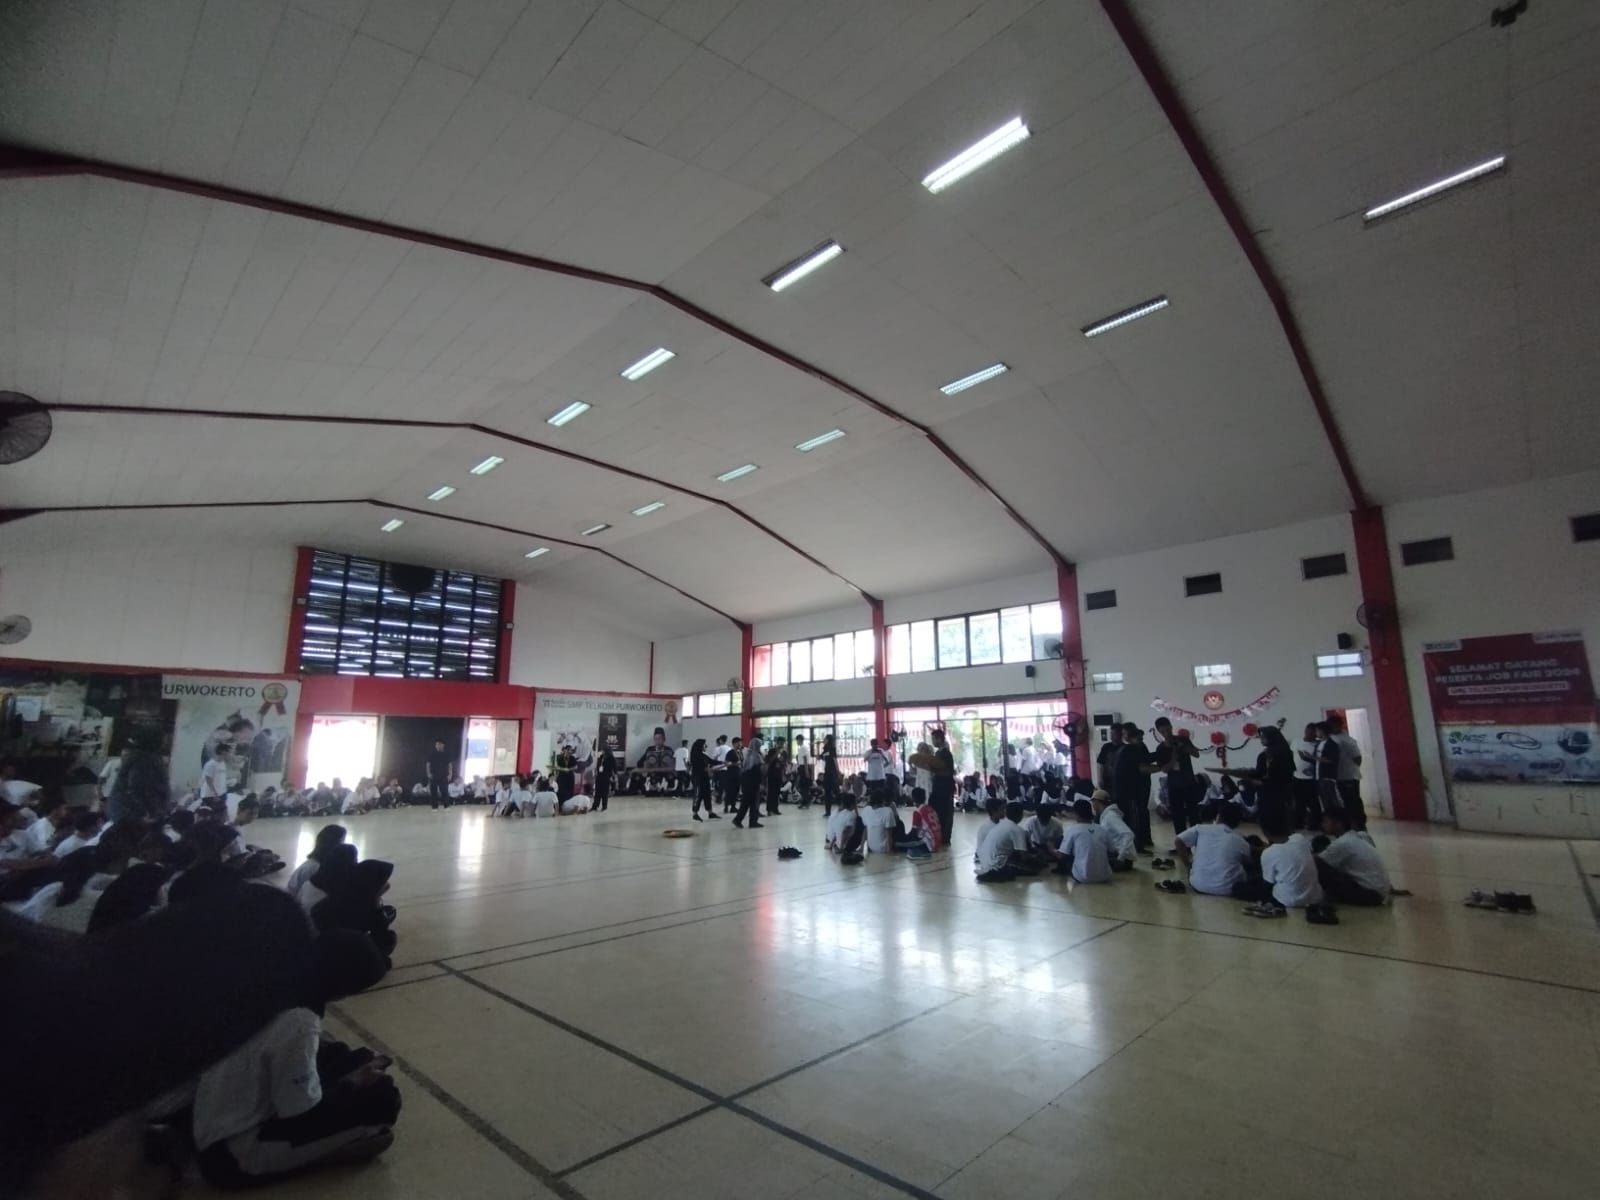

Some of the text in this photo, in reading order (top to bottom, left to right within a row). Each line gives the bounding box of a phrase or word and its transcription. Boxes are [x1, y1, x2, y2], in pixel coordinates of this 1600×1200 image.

[1449, 659, 1558, 673] SELAMAT DATANG
[1435, 673, 1483, 683] PESERTA
[1486, 671, 1511, 681] JOB
[1513, 670, 1542, 680] FAIR
[163, 683, 256, 698] URWOKERTO
[567, 700, 583, 709] SMP
[585, 701, 615, 710] TELKOM
[615, 702, 663, 712] PURWOKERTO
